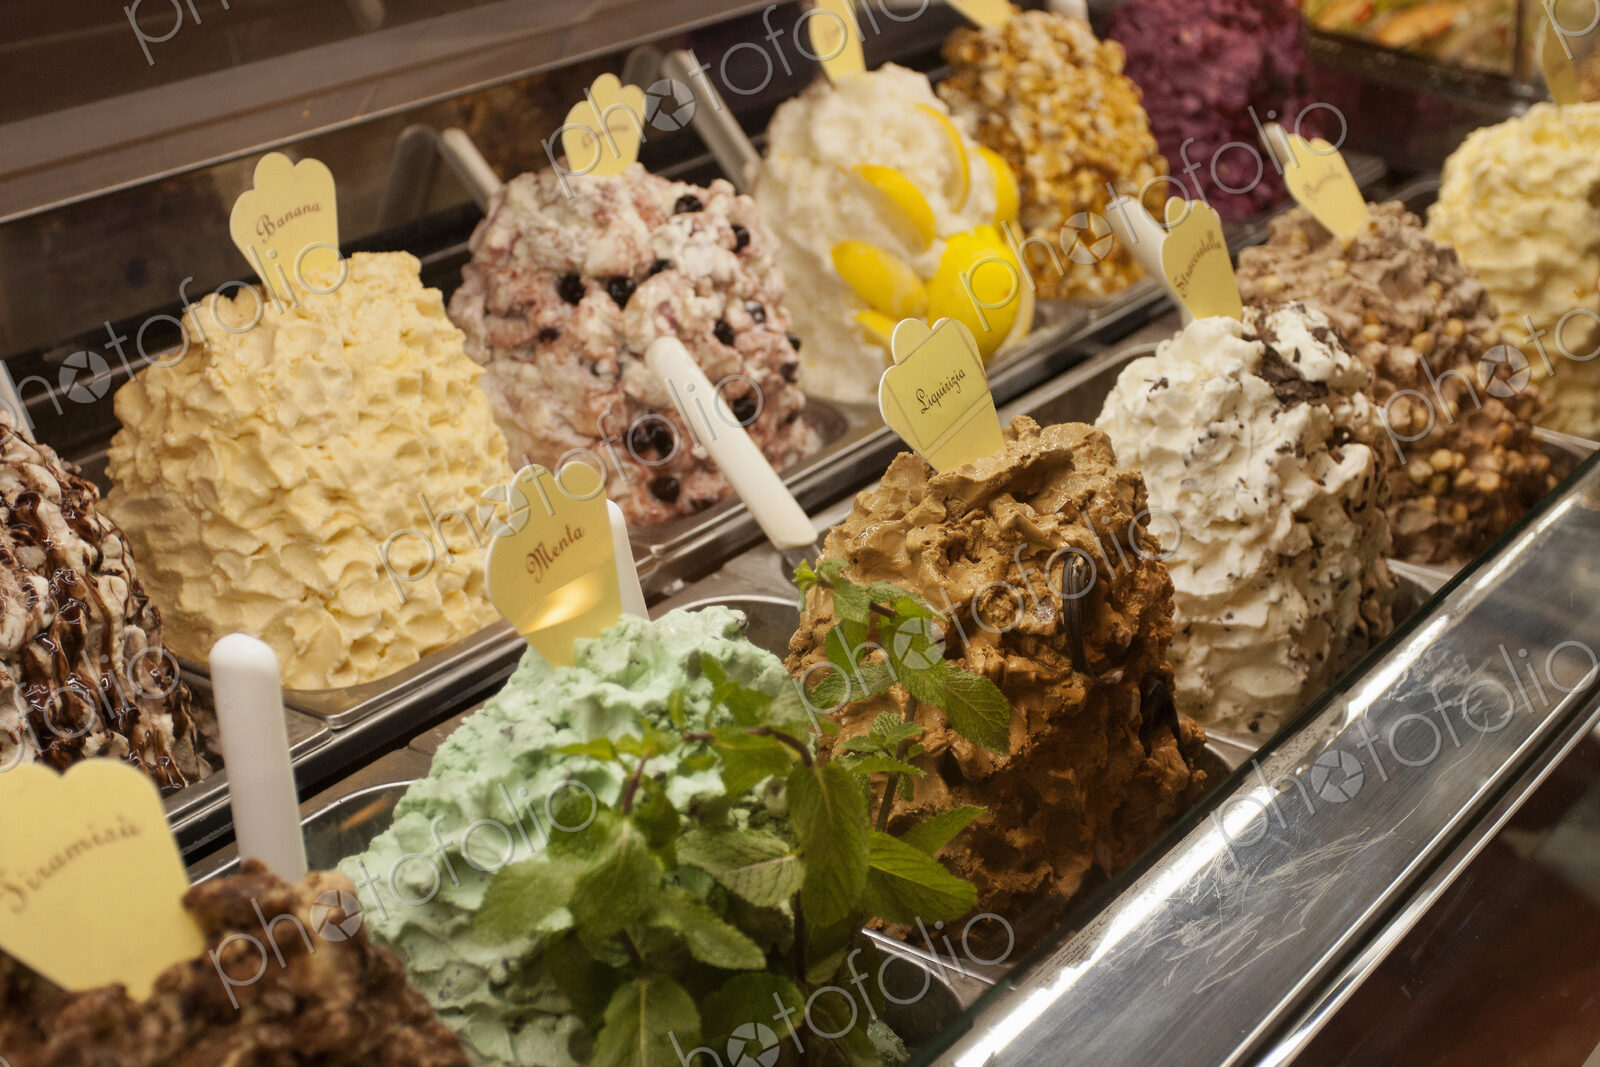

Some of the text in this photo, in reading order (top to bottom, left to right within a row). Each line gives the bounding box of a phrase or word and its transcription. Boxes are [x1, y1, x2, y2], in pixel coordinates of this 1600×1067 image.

[256, 203, 321, 244] Banana
[916, 369, 966, 414] Liquirizia
[526, 524, 584, 583] Menta
